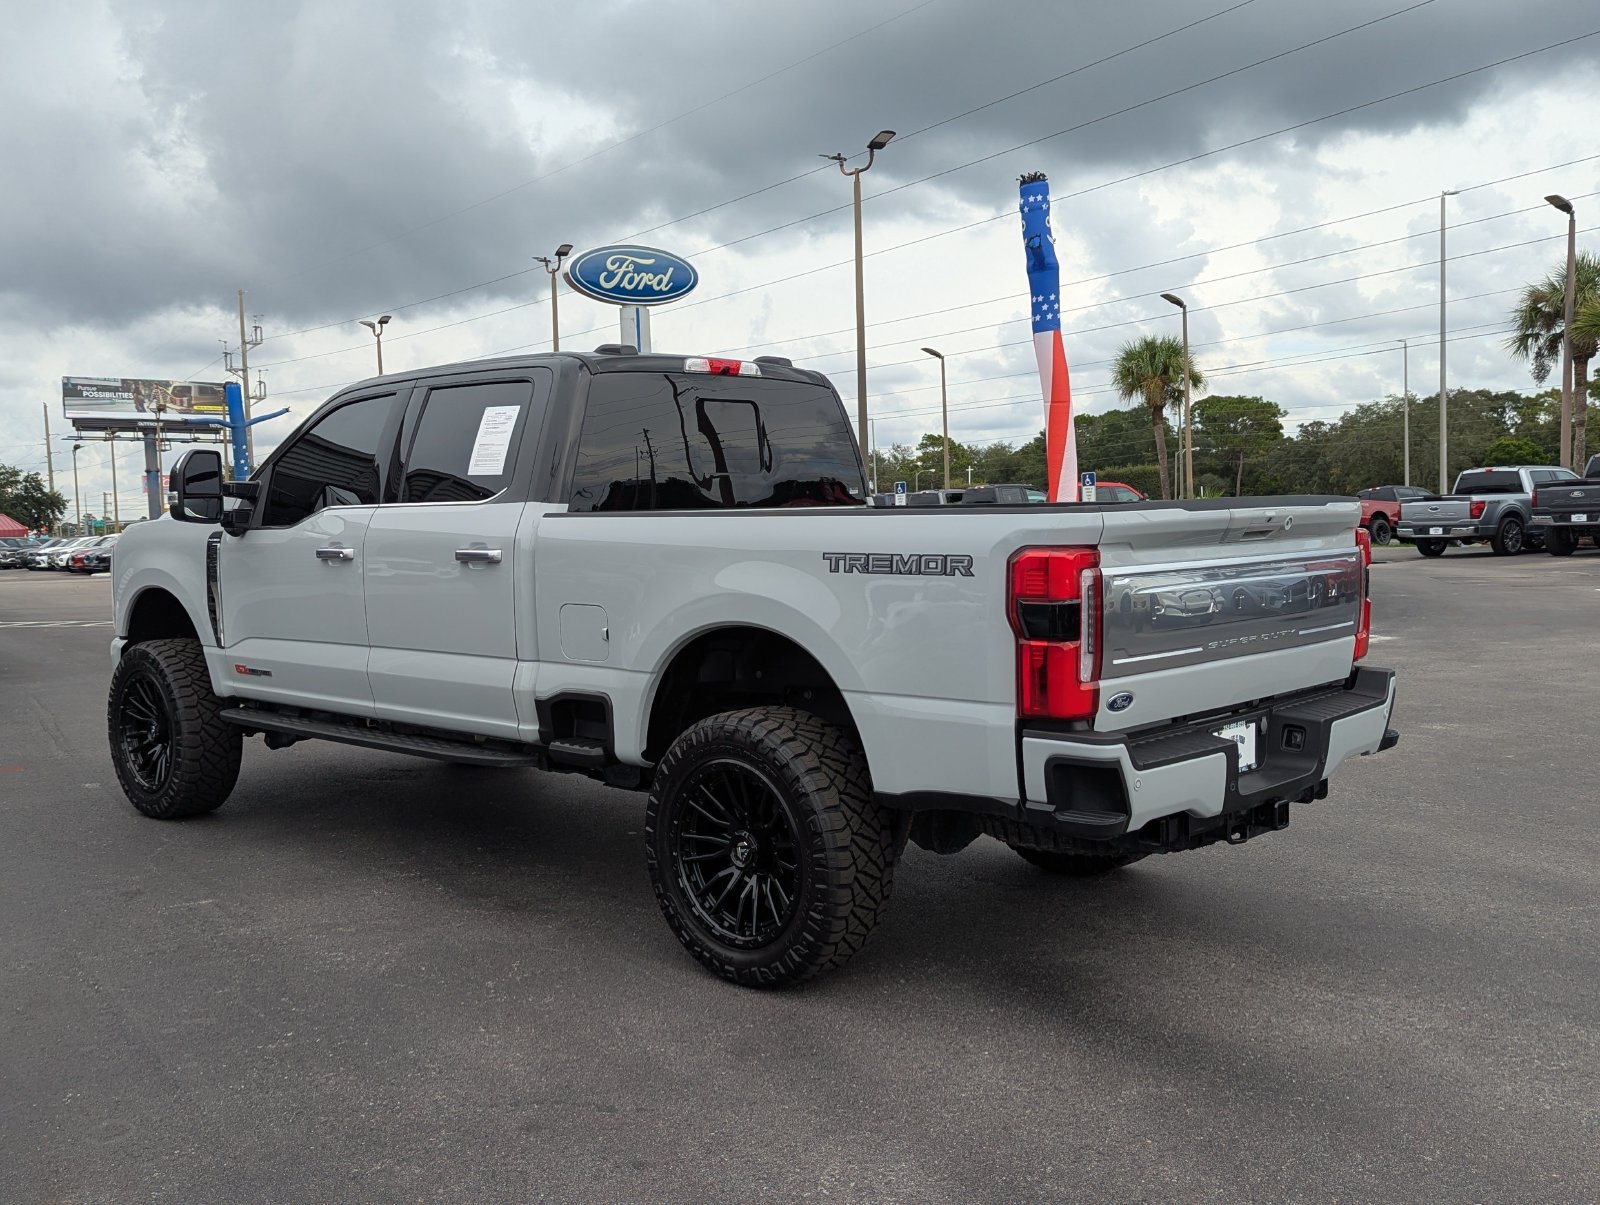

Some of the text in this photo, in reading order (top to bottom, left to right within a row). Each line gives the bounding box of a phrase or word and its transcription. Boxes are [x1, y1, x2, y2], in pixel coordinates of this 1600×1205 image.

[599, 255, 674, 291] Ford
[82, 391, 134, 399] POSSIBILITIES
[823, 552, 975, 577] TREMOR
[1208, 628, 1297, 649] SUPER DUTY
